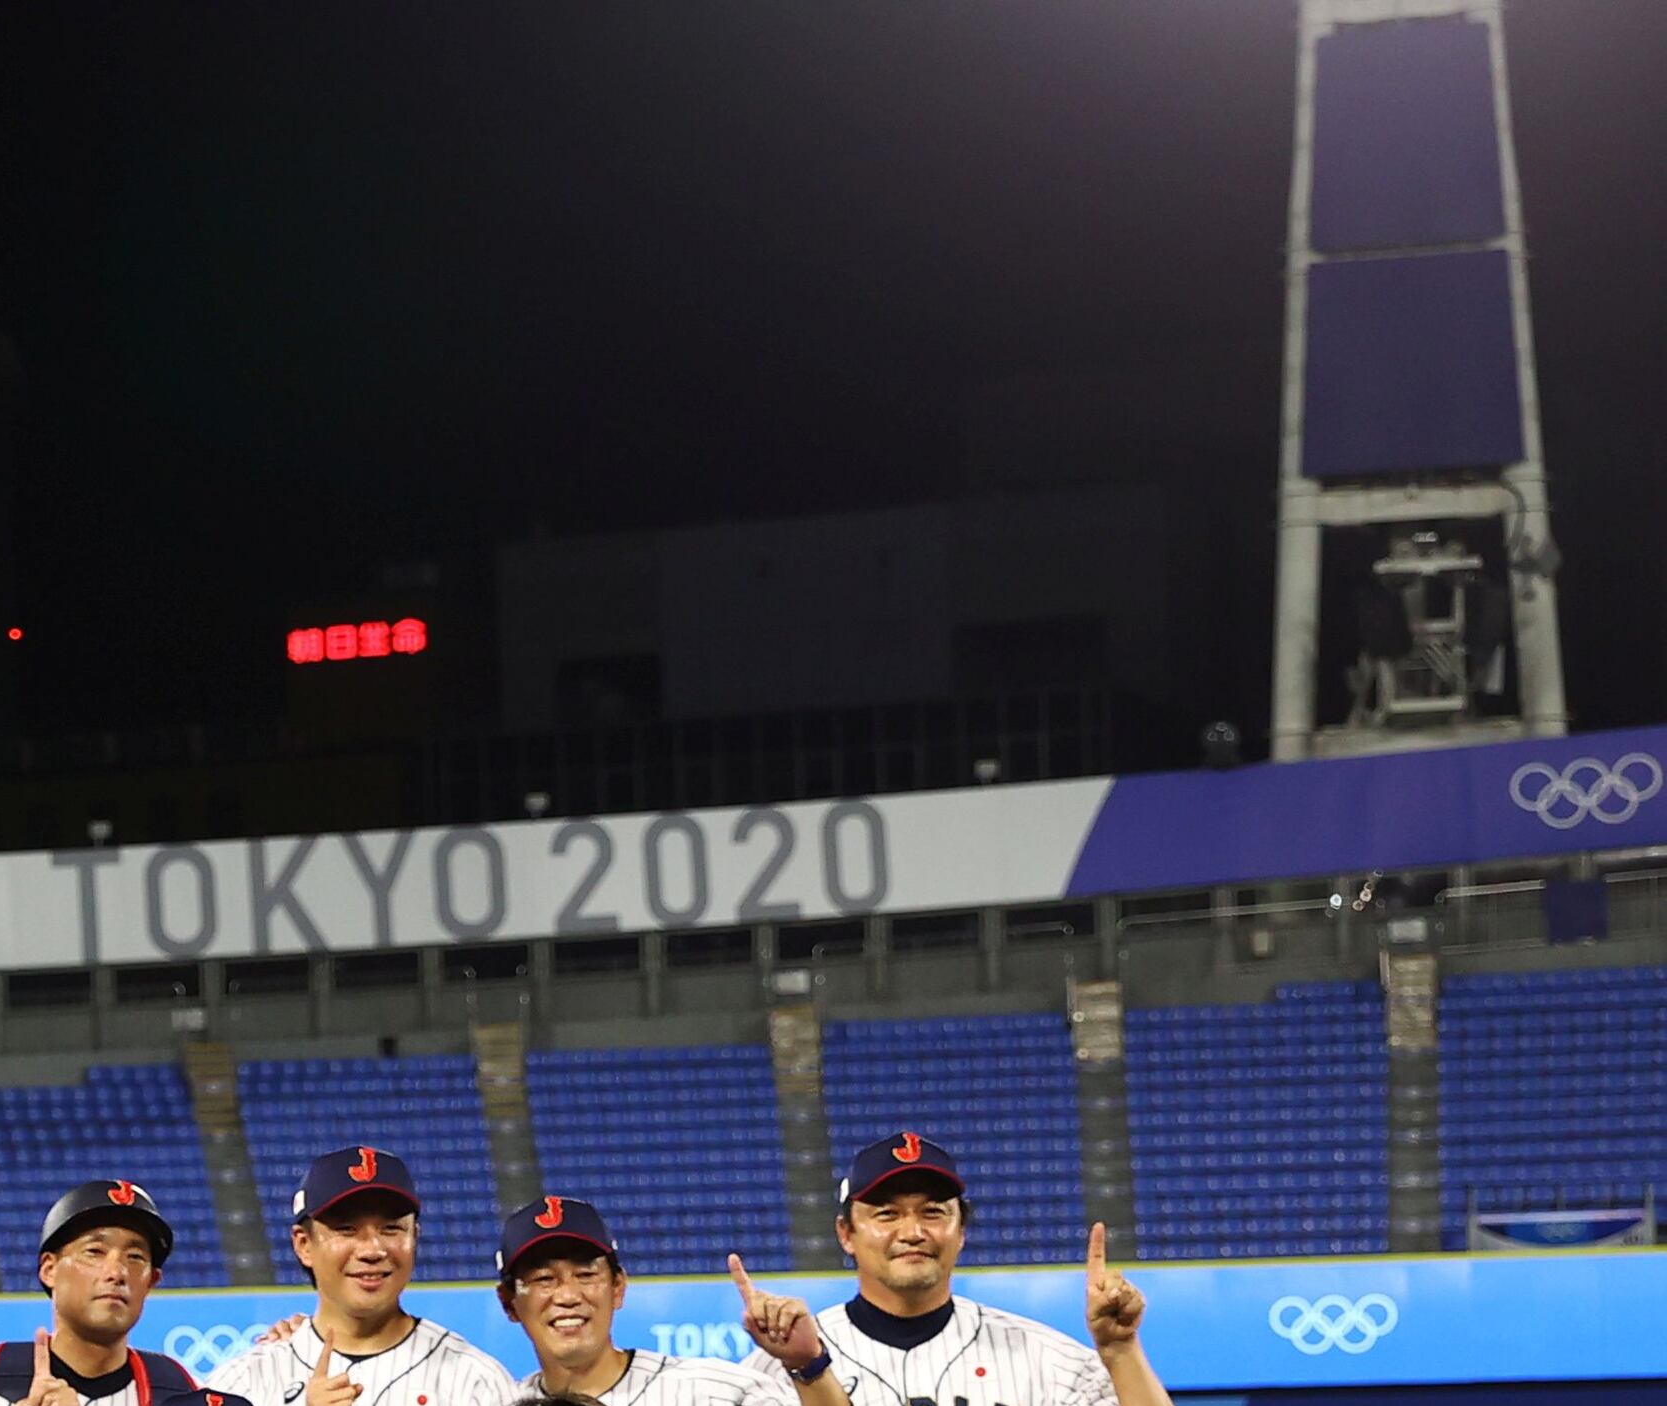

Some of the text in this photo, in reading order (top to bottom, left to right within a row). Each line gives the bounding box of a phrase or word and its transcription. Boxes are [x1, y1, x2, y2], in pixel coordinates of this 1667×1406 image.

[51, 800, 890, 967] TOKYO 2020
[348, 1147, 377, 1182] J
[892, 1132, 922, 1163] J
[107, 1181, 136, 1206] J
[534, 1196, 564, 1229] J
[650, 1322, 751, 1362] TOKY
